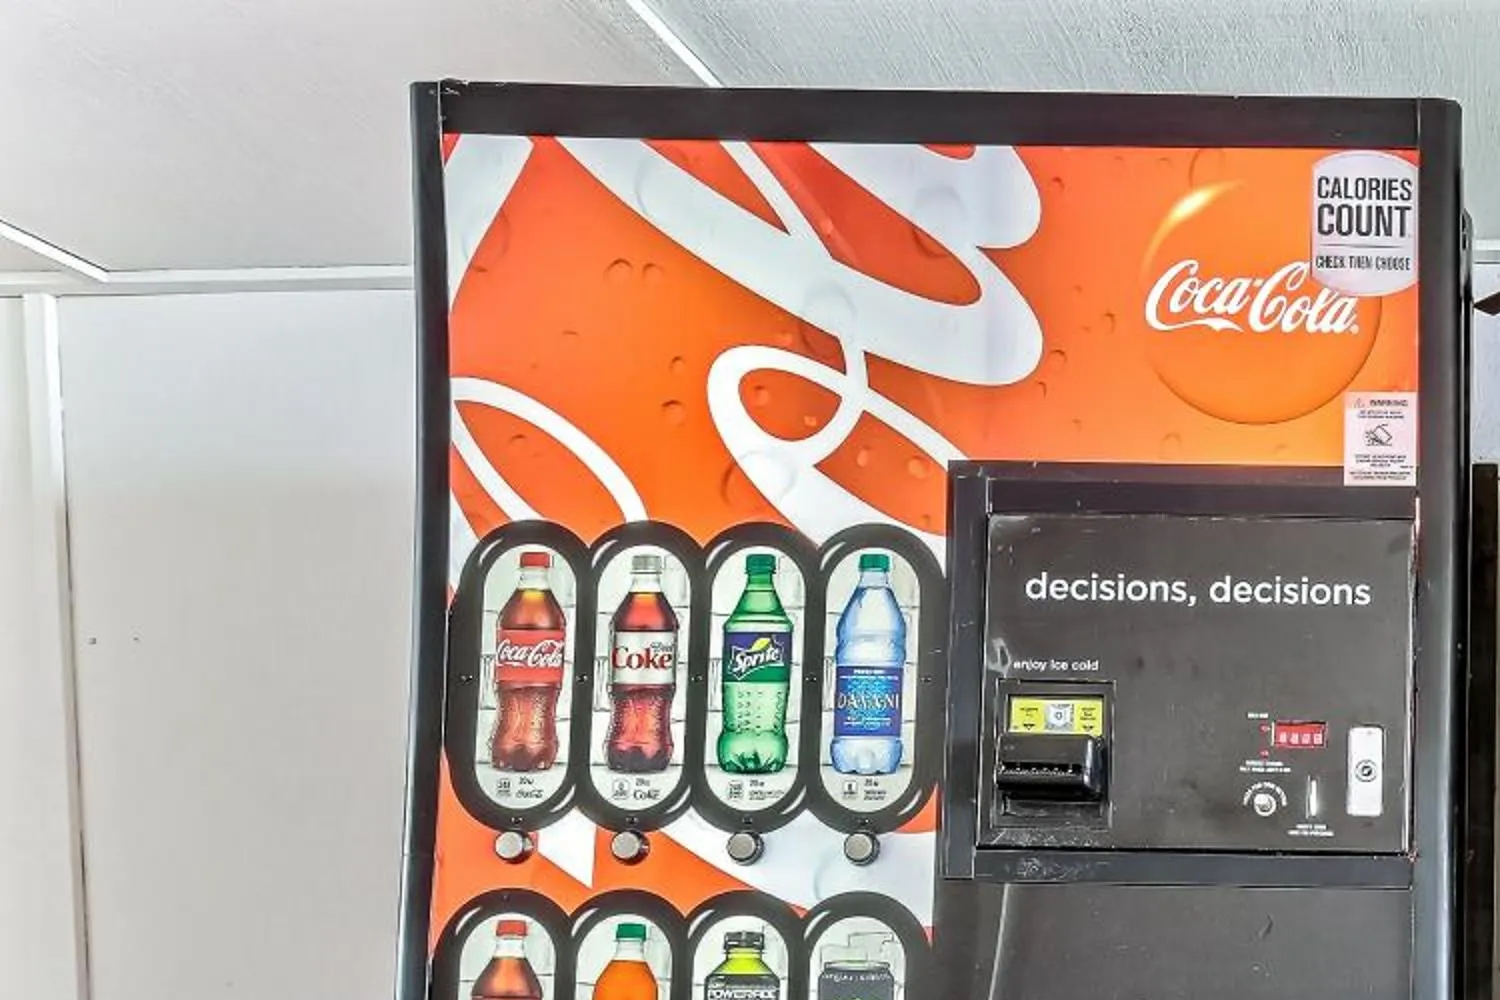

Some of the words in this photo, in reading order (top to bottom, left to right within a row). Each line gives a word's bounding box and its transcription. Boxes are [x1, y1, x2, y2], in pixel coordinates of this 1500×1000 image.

[1316, 175, 1412, 201] CALORIES
[1316, 203, 1412, 238] COUNT
[1315, 255, 1346, 269] CHECK
[1348, 255, 1372, 269] THEN
[1375, 256, 1411, 272] CHOOSE
[1144, 260, 1360, 334] Coca-Cola
[1024, 571, 1198, 608] decisions,
[1209, 574, 1372, 607] decisions
[496, 638, 565, 668] Coca-Cola
[611, 646, 673, 670] Coke
[733, 646, 781, 673] Sprite
[1013, 659, 1048, 672] enjoy
[1051, 658, 1069, 670] ice
[1071, 659, 1100, 672] cold
